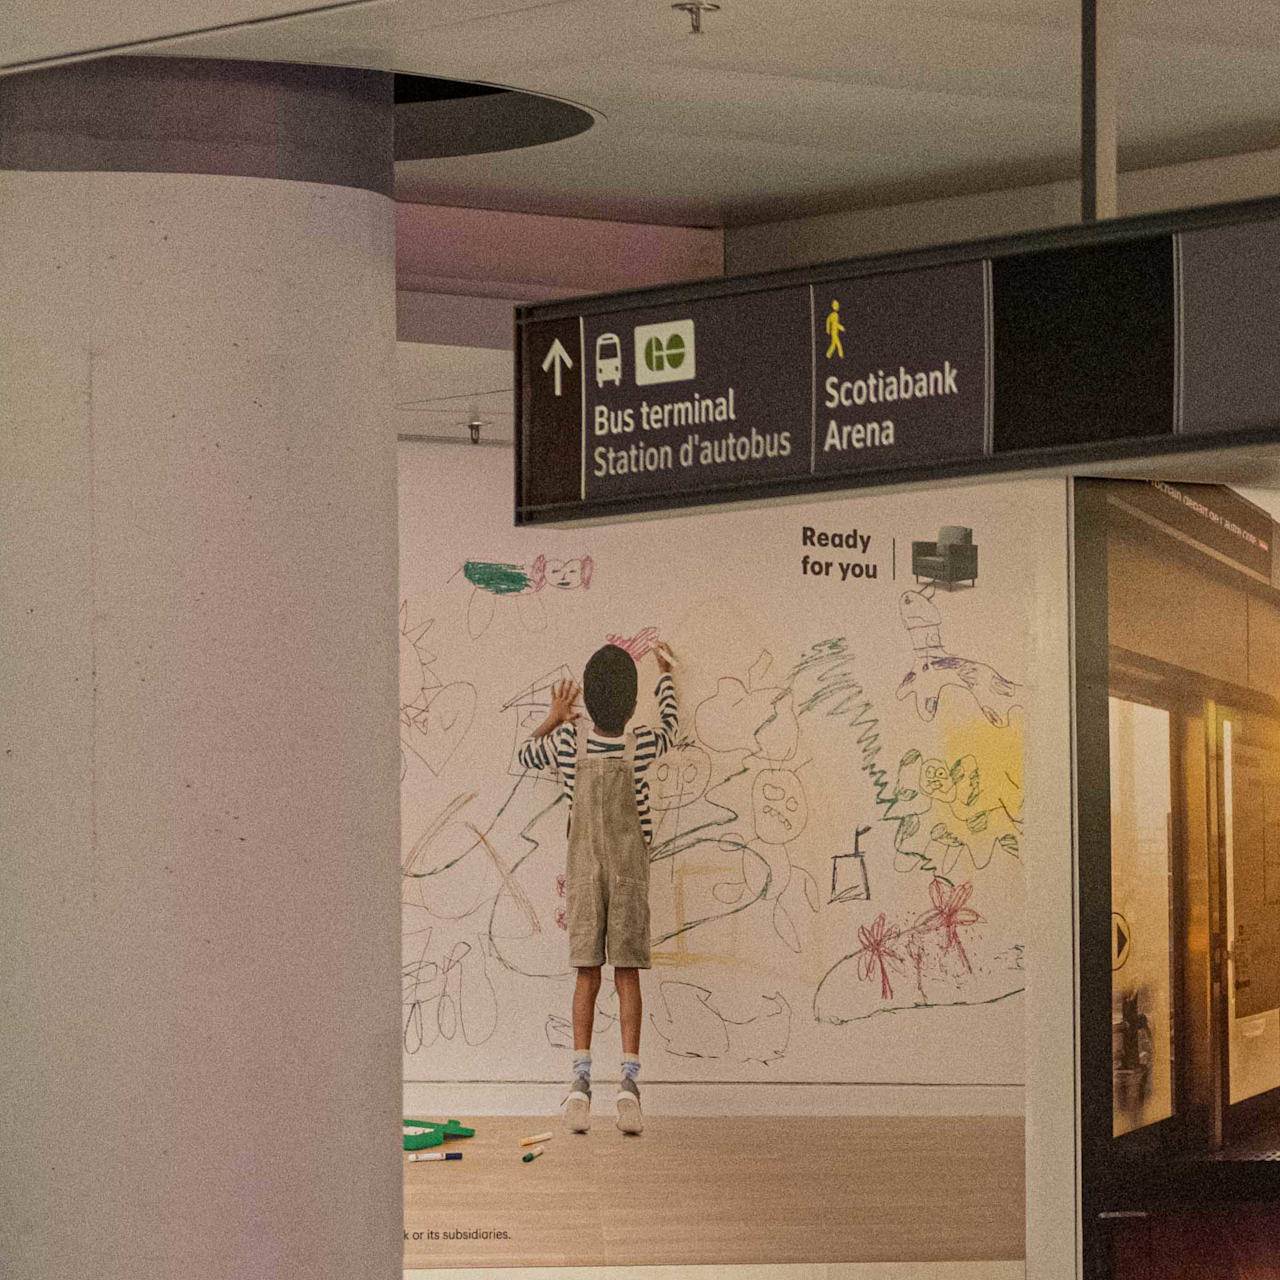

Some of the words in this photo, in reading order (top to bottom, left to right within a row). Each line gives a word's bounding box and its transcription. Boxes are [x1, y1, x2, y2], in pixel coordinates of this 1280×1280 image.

[825, 360, 958, 408] Scotiabank
[594, 404, 635, 435] Bus
[640, 387, 736, 430] terminal
[594, 440, 672, 477] Station
[680, 427, 791, 467] d'autobus
[823, 419, 895, 452] Arena
[802, 526, 871, 553] Ready
[801, 554, 833, 576] for
[838, 562, 877, 581] you
[412, 1231, 424, 1240] or
[427, 1229, 440, 1240] its
[442, 1228, 512, 1240] subsidiaries.
